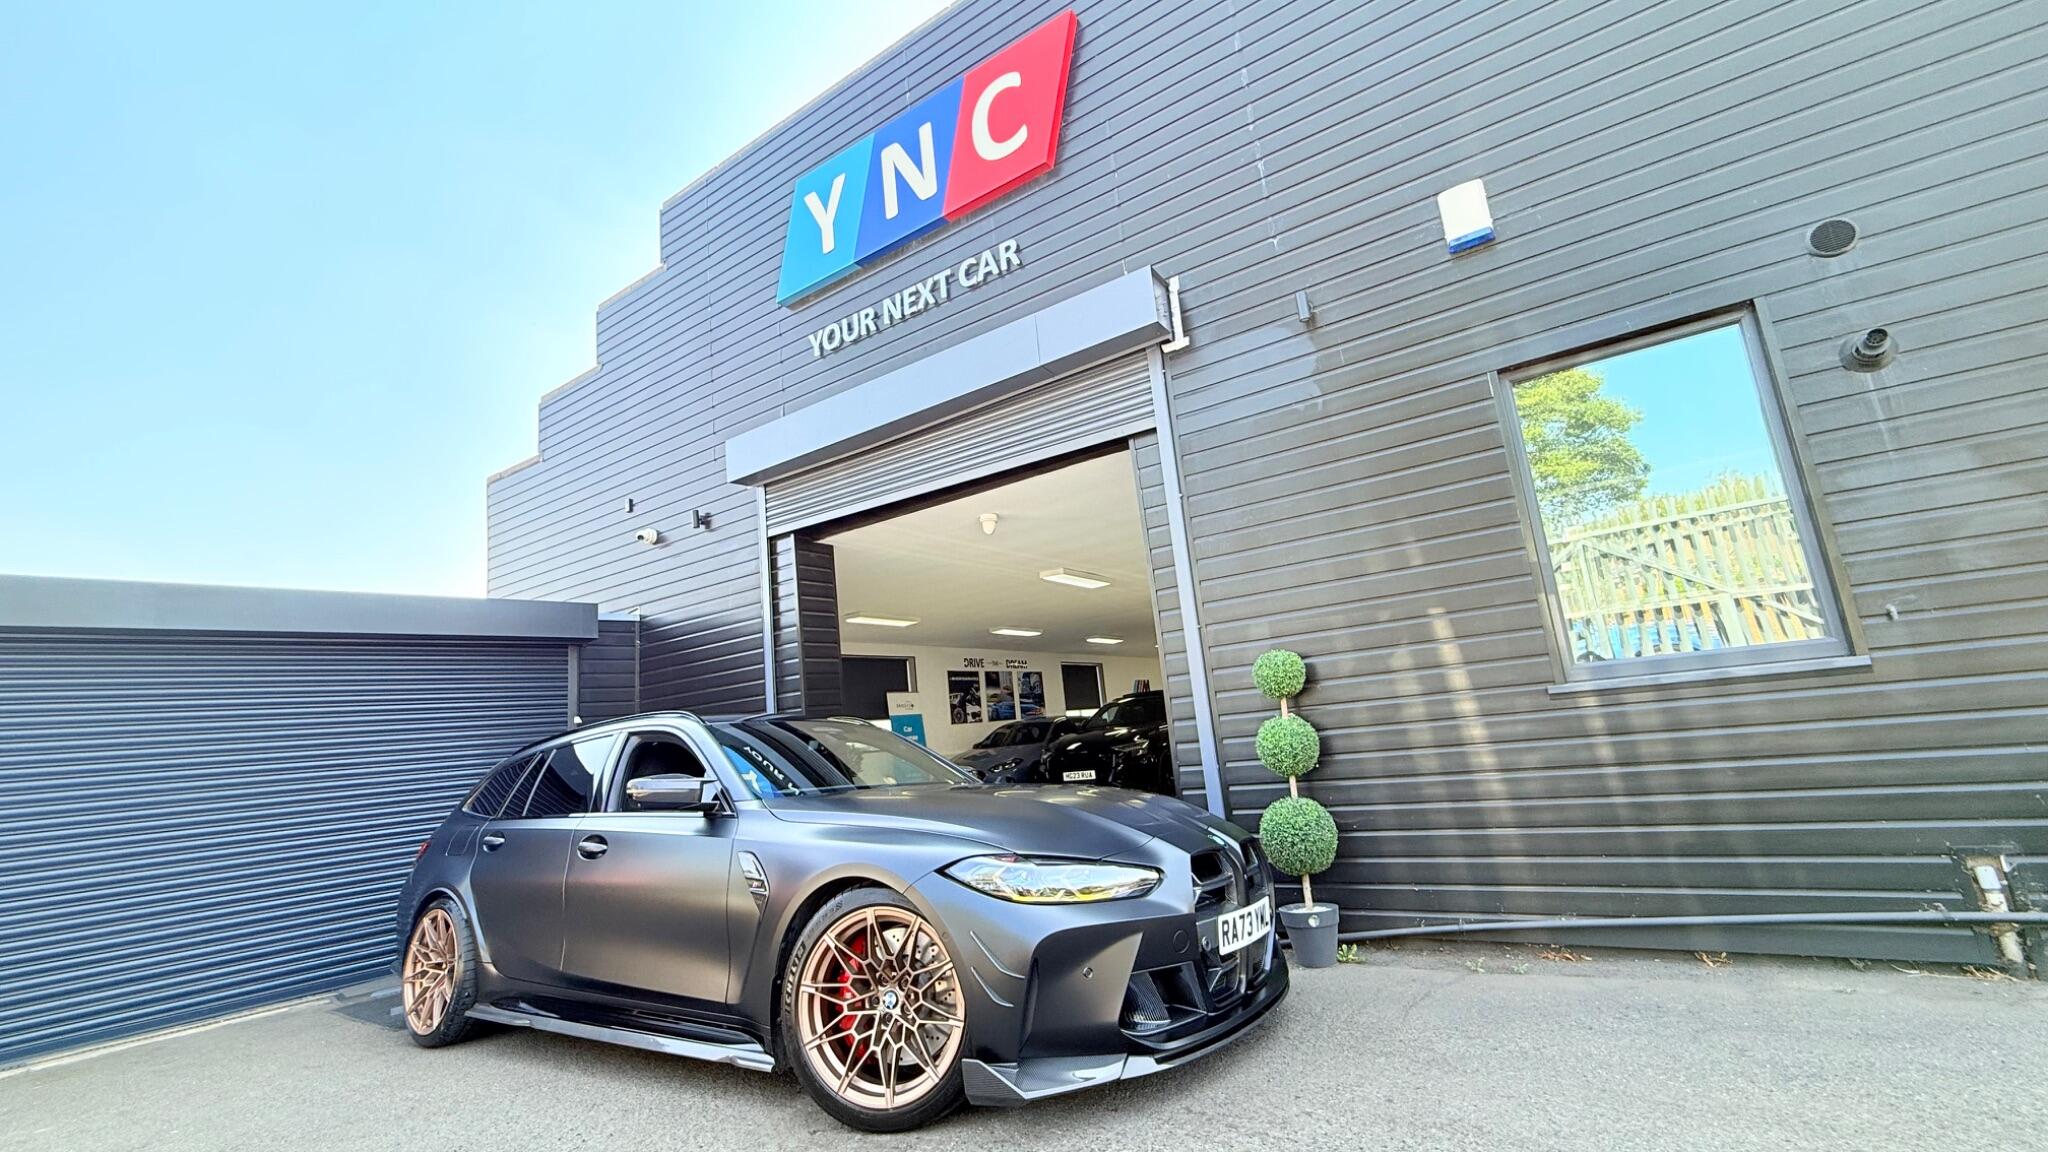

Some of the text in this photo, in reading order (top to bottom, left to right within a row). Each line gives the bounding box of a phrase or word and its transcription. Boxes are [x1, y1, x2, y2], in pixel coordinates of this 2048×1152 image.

[808, 238, 1021, 358] YOUR NEXT CAR
[963, 657, 985, 669] DRIVE
[1221, 911, 1253, 948] RA73
